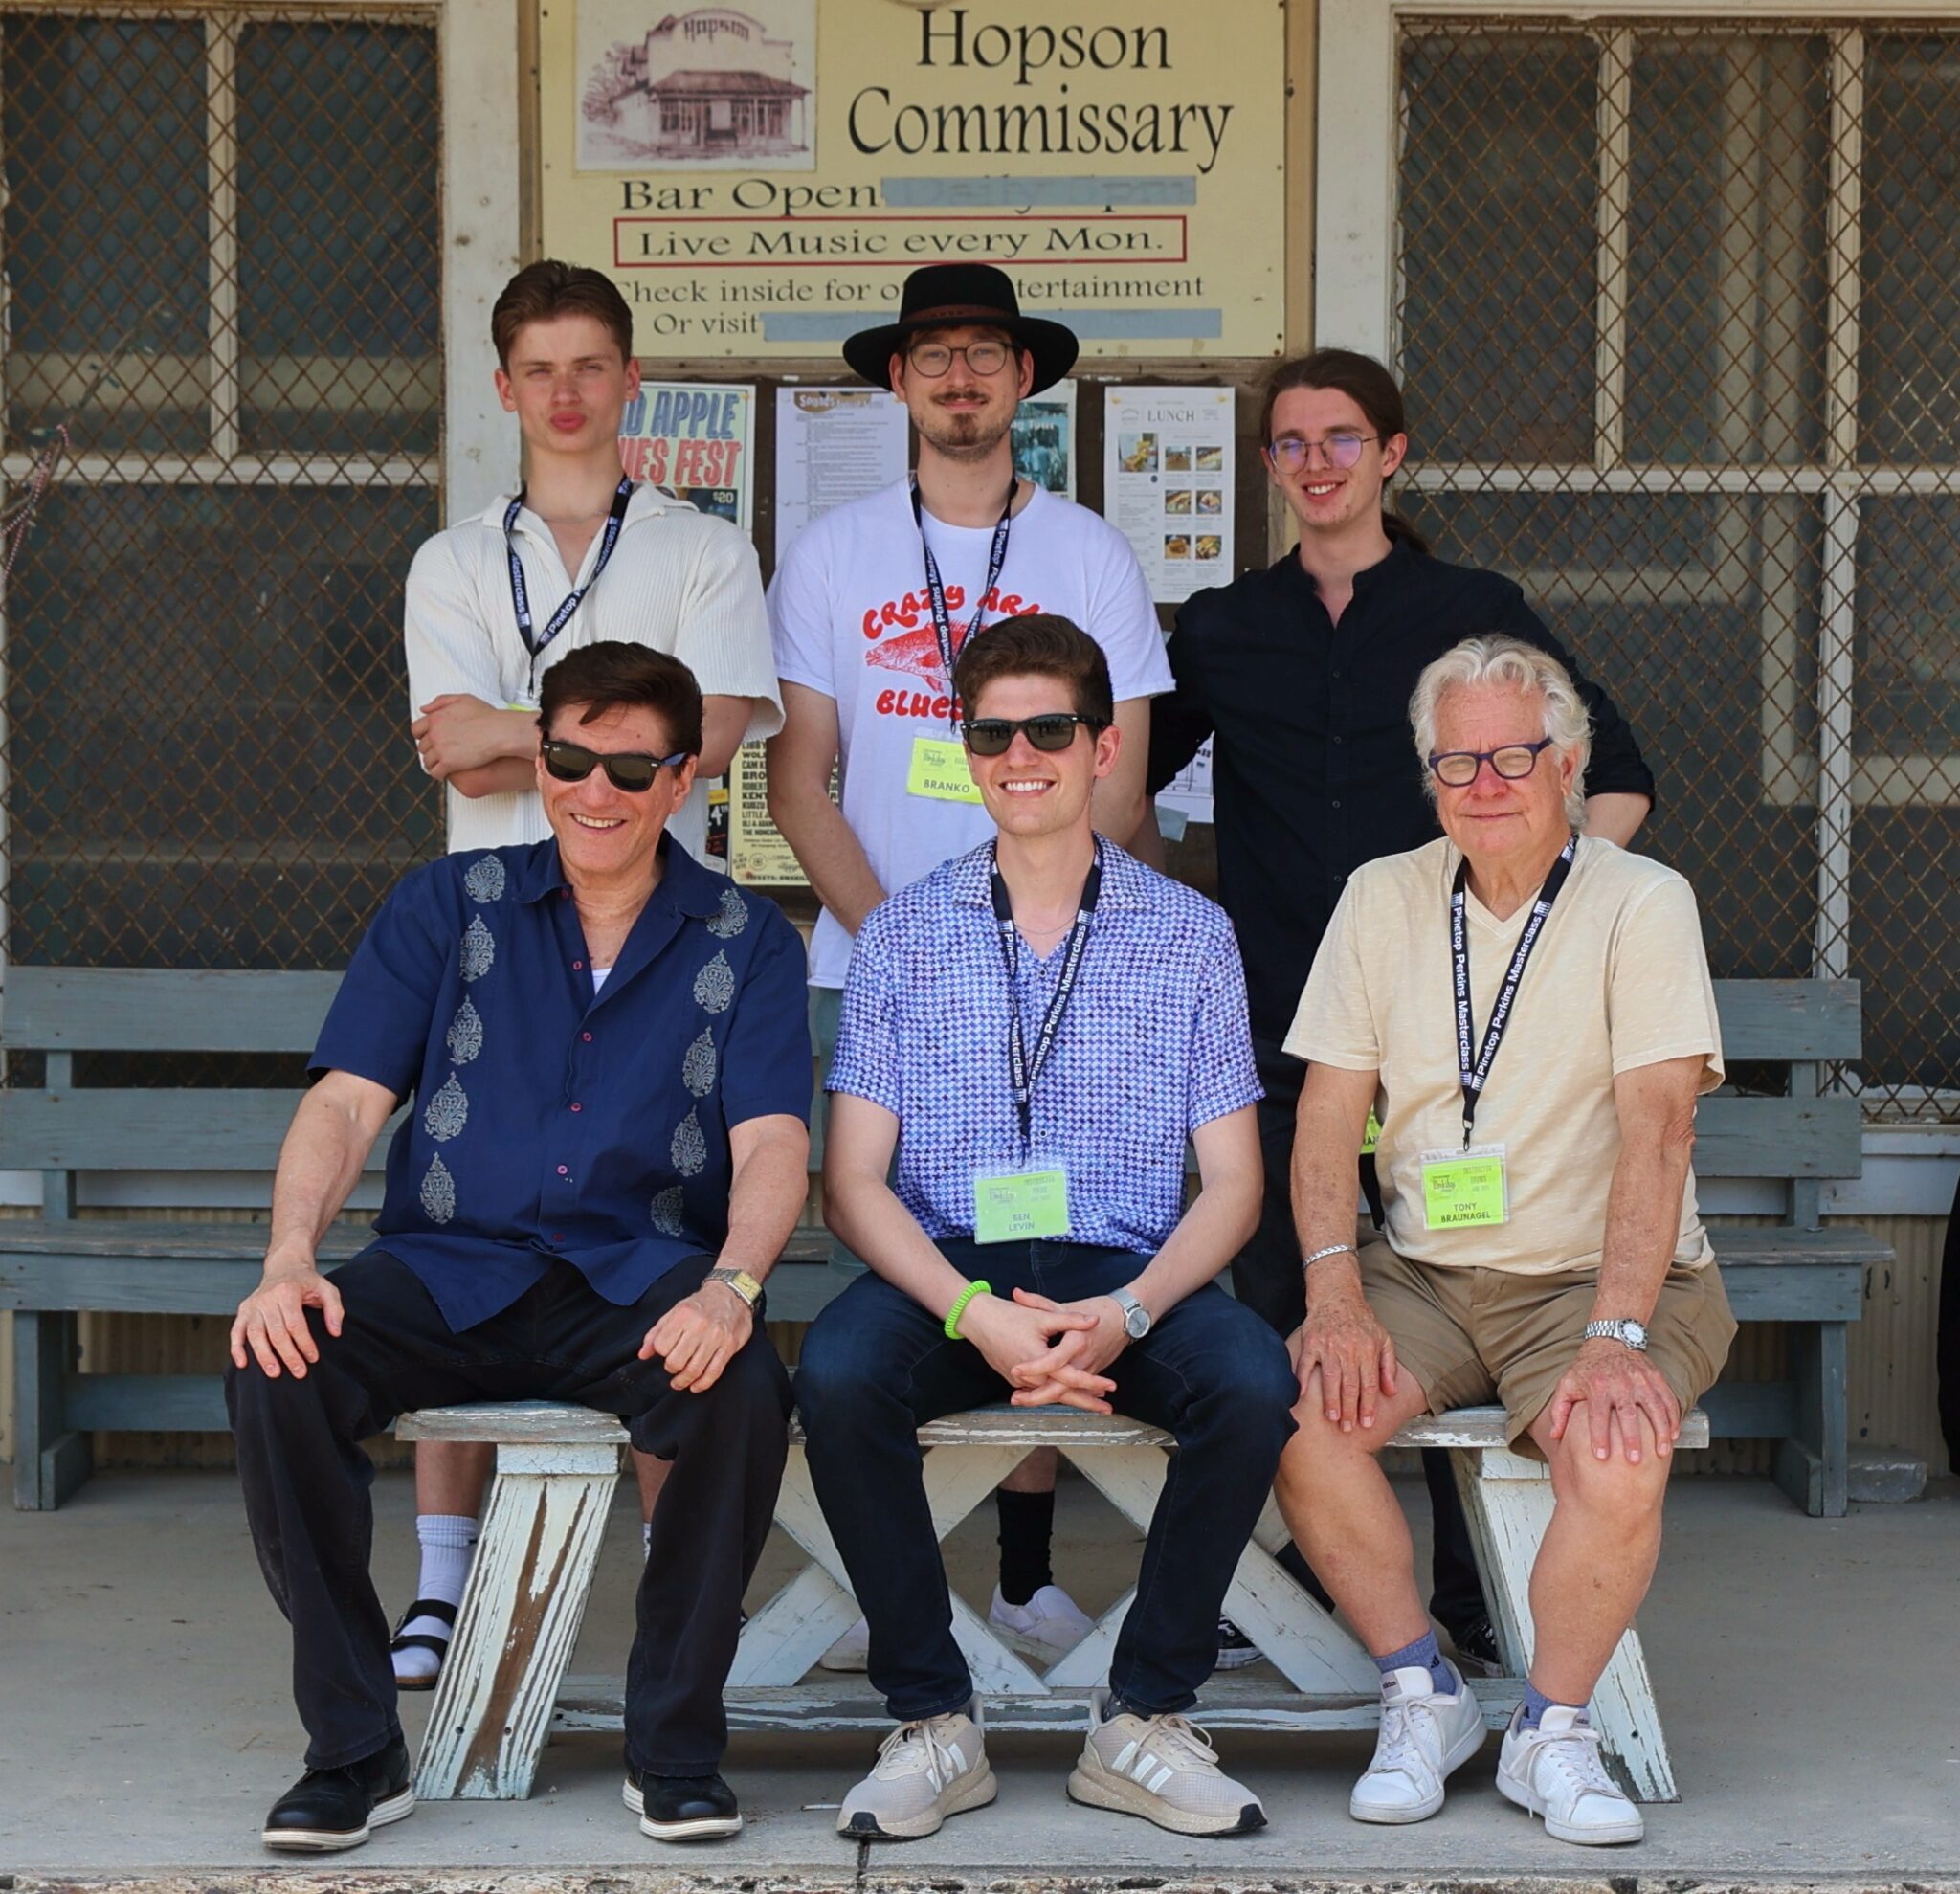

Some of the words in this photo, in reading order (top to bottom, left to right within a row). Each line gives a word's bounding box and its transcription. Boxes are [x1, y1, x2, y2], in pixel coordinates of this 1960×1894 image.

[915, 9, 1173, 86] Hopson
[848, 83, 1234, 174] Commissary
[620, 180, 713, 211] Bar
[732, 178, 880, 216] Open
[639, 231, 732, 256] Live
[747, 229, 887, 256] Music
[903, 231, 1030, 258] every
[1044, 227, 1163, 252] Mon.
[719, 279, 813, 302] inside
[825, 279, 871, 301] for
[1017, 275, 1204, 300] tertainment
[653, 313, 692, 335] Or
[702, 312, 758, 334] visit
[650, 391, 740, 439] APPLE
[1148, 410, 1194, 422] LUNCH
[674, 439, 743, 487] FEST
[547, 597, 576, 634] Pinetop
[932, 586, 946, 624] Perkins
[924, 779, 970, 793] BRANKO
[1452, 906, 1464, 951] Pinetop
[1004, 932, 1016, 976] Pinetop
[1455, 953, 1466, 997] Perkins
[1031, 1036, 1051, 1081] Pinetop
[1044, 993, 1066, 1035] Perkins
[1062, 924, 1087, 992] Masterclass
[1477, 1030, 1499, 1076] Pinetop
[1491, 984, 1514, 1029] Perkins
[1508, 914, 1543, 983] Masterclass
[1010, 1016, 1023, 1088] Masterclass
[1457, 1000, 1470, 1070] Masterclass
[1013, 1213, 1031, 1222] BEN
[1440, 1211, 1491, 1223] BRAUNAGEL
[1454, 1202, 1477, 1212] TONY
[1009, 1221, 1035, 1232] LEVIN
